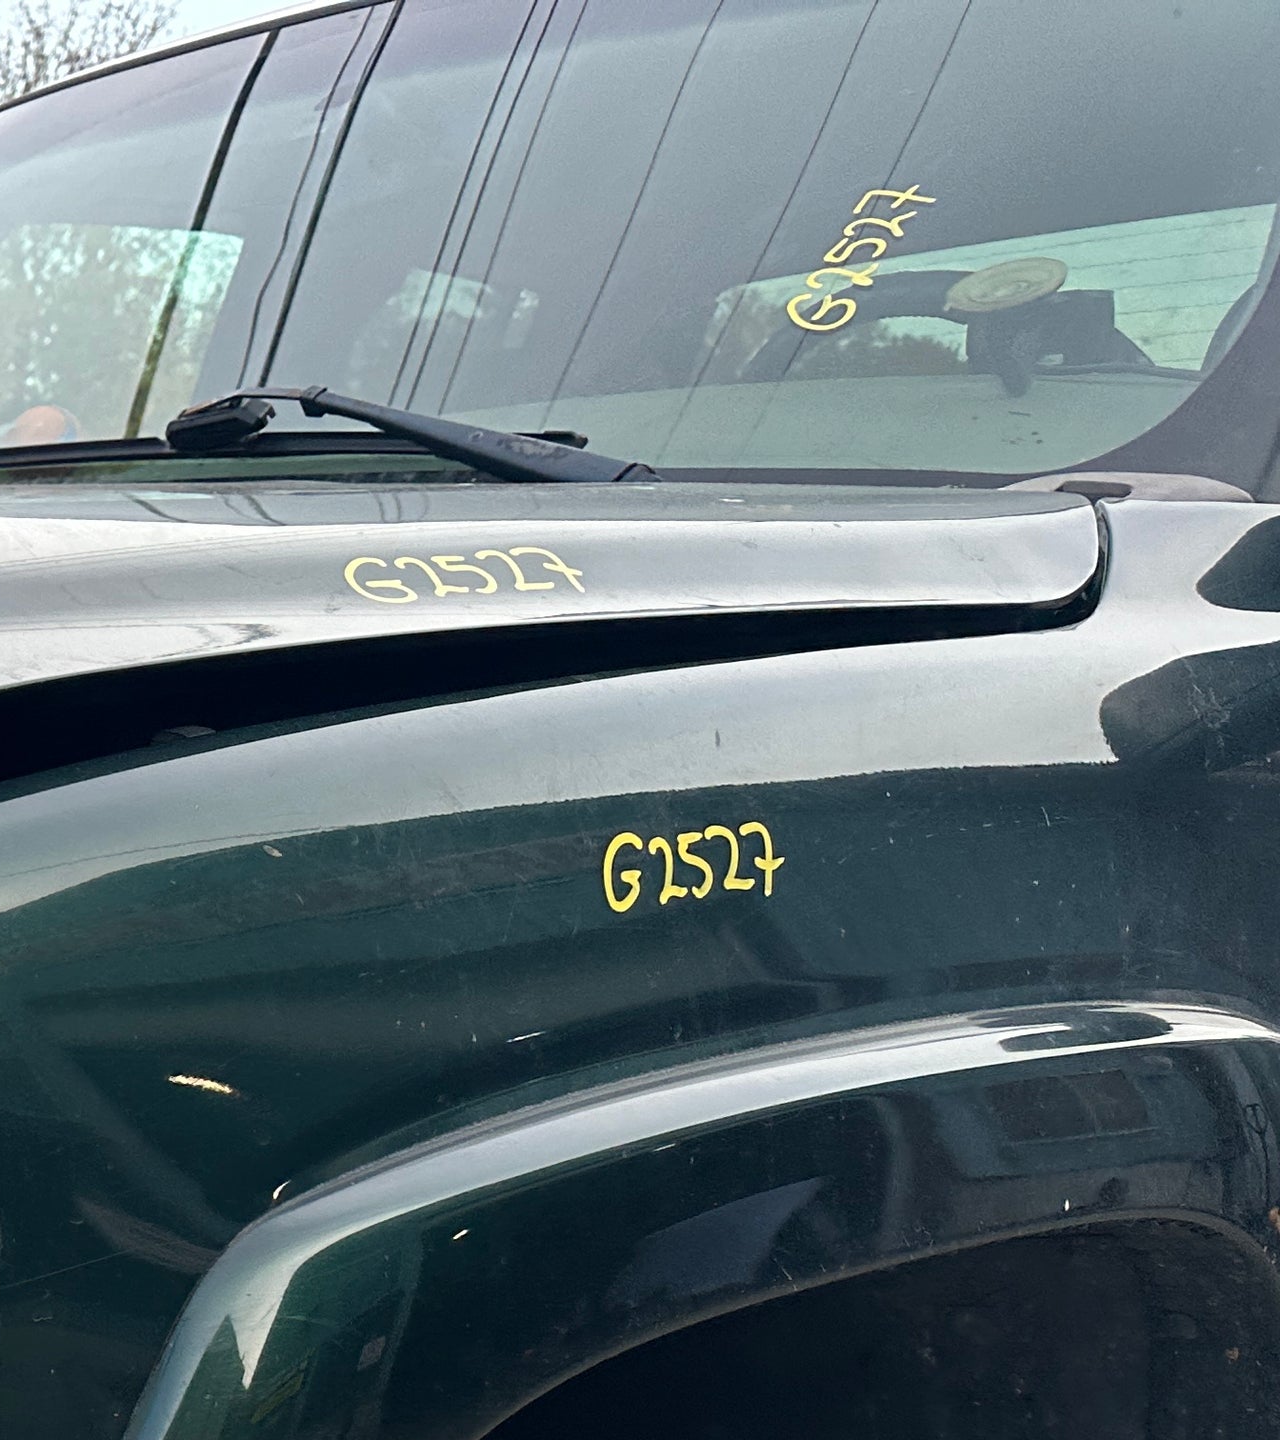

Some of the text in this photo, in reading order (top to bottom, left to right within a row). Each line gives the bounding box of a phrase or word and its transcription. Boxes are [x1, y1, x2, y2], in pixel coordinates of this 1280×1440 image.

[786, 184, 937, 331] G2527
[344, 547, 585, 604] G2527
[603, 821, 786, 913] G2527
